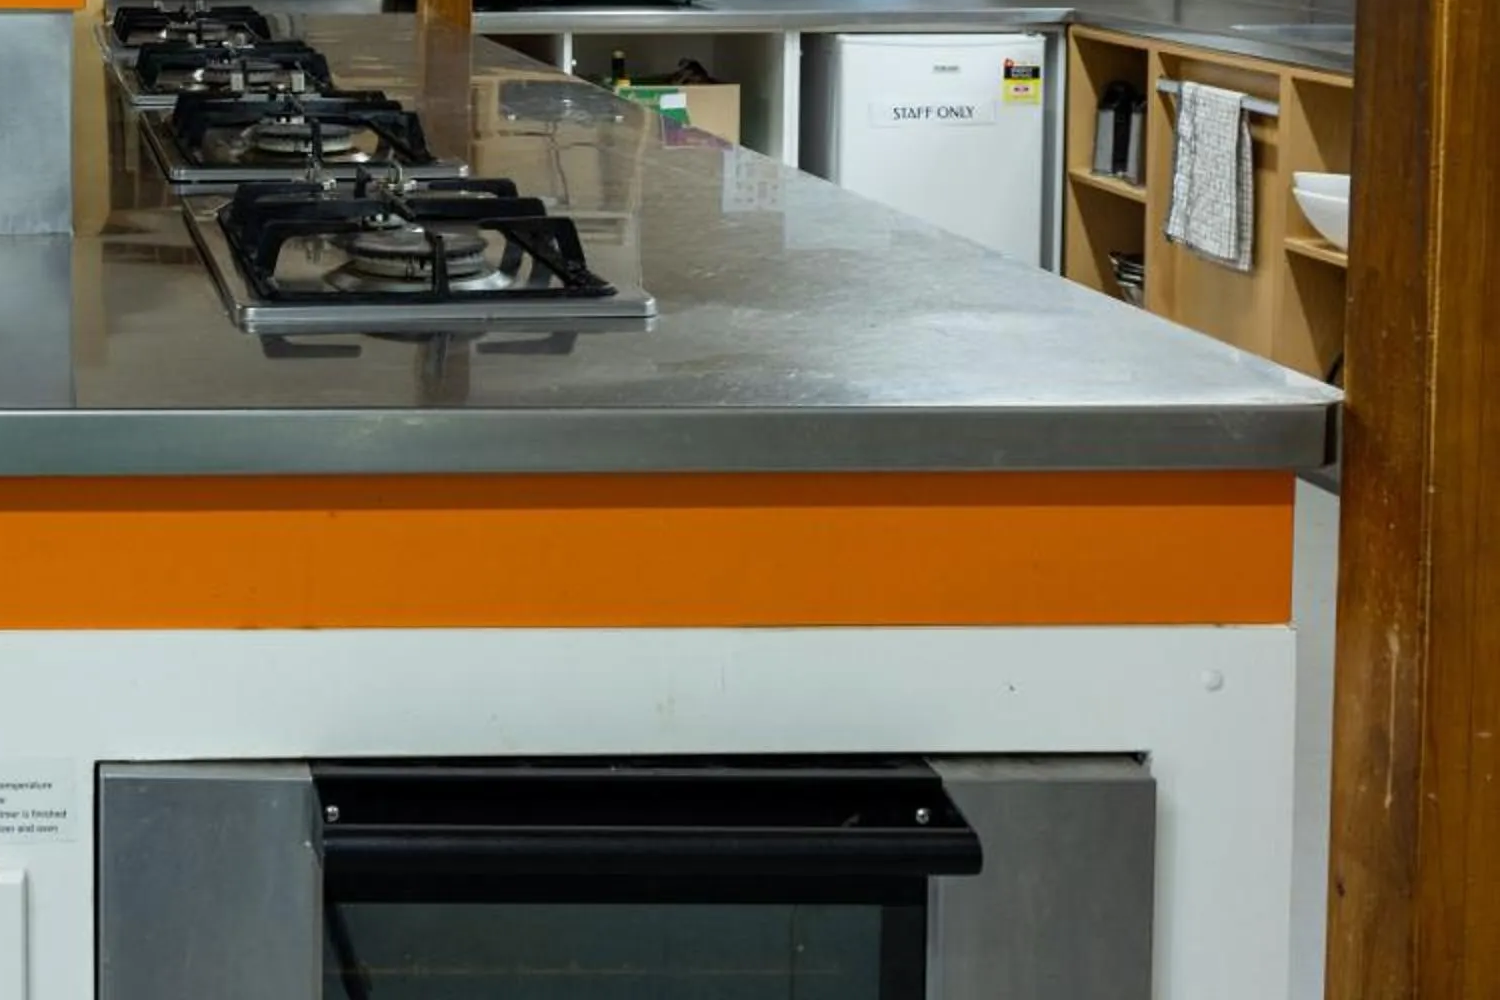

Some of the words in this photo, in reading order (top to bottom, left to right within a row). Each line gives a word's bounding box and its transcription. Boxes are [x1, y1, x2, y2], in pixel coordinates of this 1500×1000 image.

[893, 107, 932, 120] STAFF
[936, 105, 975, 119] ONLY
[21, 810, 30, 819] is
[31, 809, 67, 818] finished
[17, 824, 35, 833] and
[36, 825, 59, 833] oven
